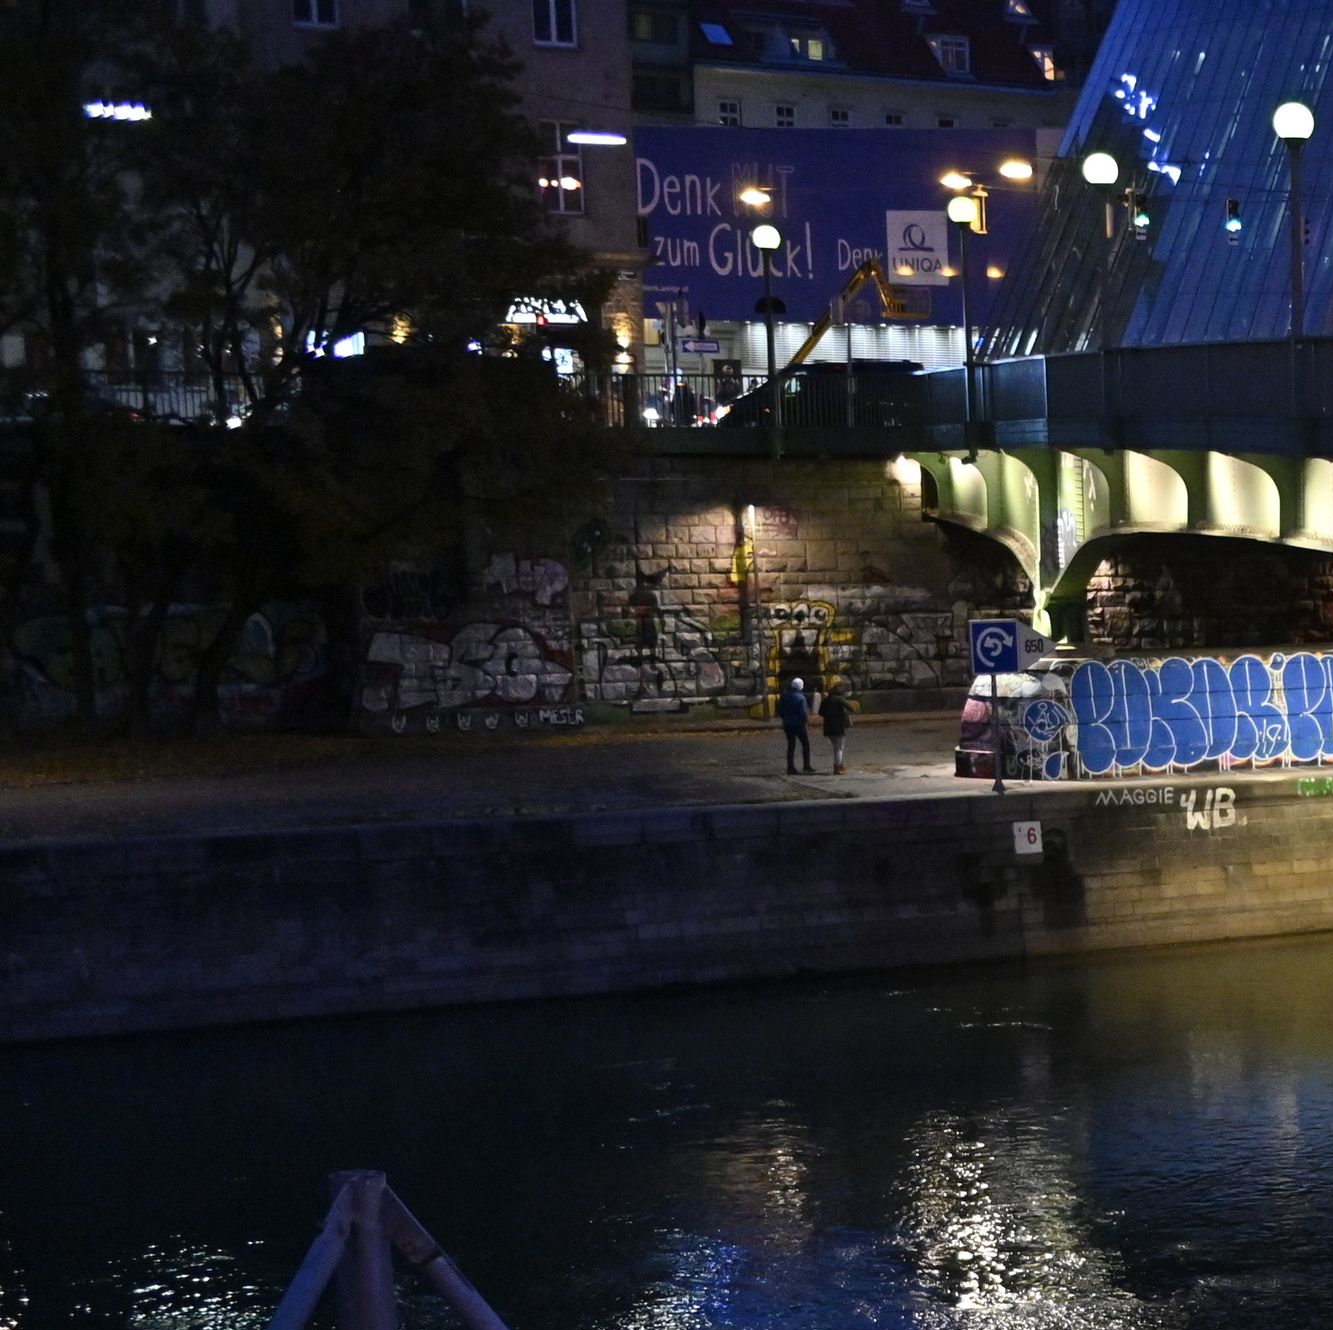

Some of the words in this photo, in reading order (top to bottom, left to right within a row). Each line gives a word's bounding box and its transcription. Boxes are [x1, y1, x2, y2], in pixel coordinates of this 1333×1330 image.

[636, 157, 722, 217] Denk
[653, 237, 700, 267] zum
[1024, 638, 1045, 654] 650
[1096, 787, 1174, 806] MAGGIE
[1027, 827, 1037, 845] 6
